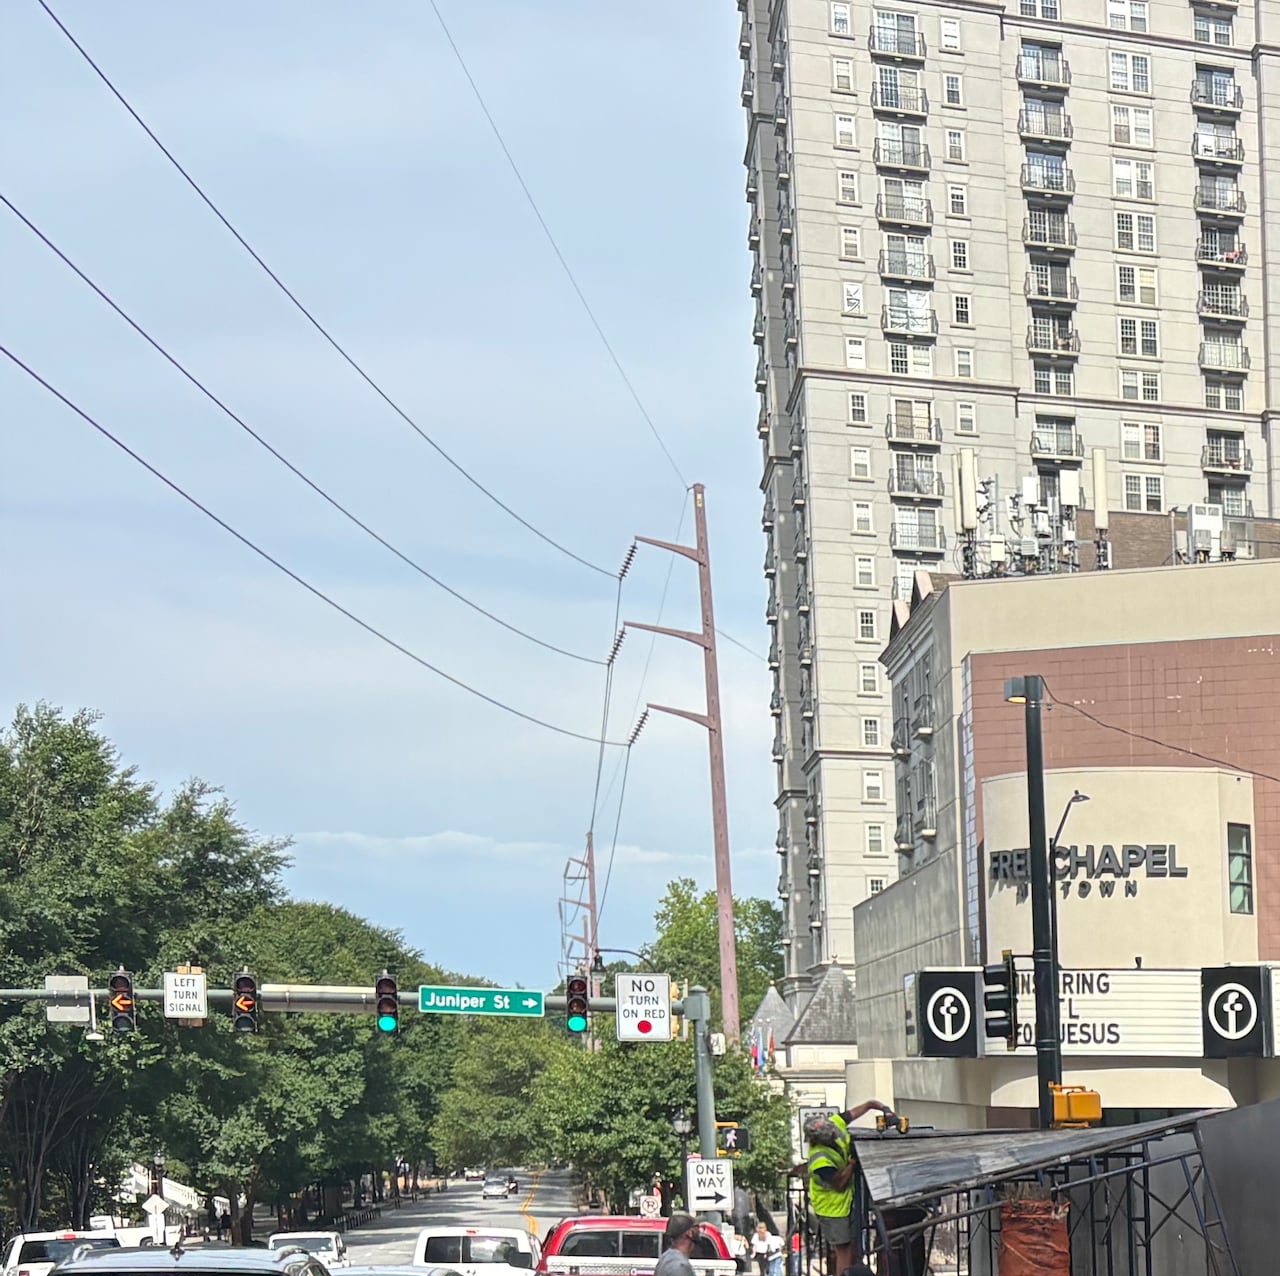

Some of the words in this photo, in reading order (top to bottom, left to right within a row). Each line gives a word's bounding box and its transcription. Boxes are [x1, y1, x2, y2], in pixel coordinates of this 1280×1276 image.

[1054, 845, 1188, 879] CHAPEL
[174, 978, 196, 987] LEFT
[631, 979, 655, 992] NO
[173, 990, 198, 999] TURN
[628, 995, 659, 1005] TURN
[425, 992, 486, 1010] Juniper
[493, 994, 510, 1009] St
[169, 1002, 203, 1012] SIGNAL
[622, 1008, 638, 1018] ON
[644, 1008, 666, 1019] RED
[1059, 1023, 1120, 1044] JESUS
[695, 1164, 724, 1175] ONE
[697, 1177, 726, 1188] WAY
